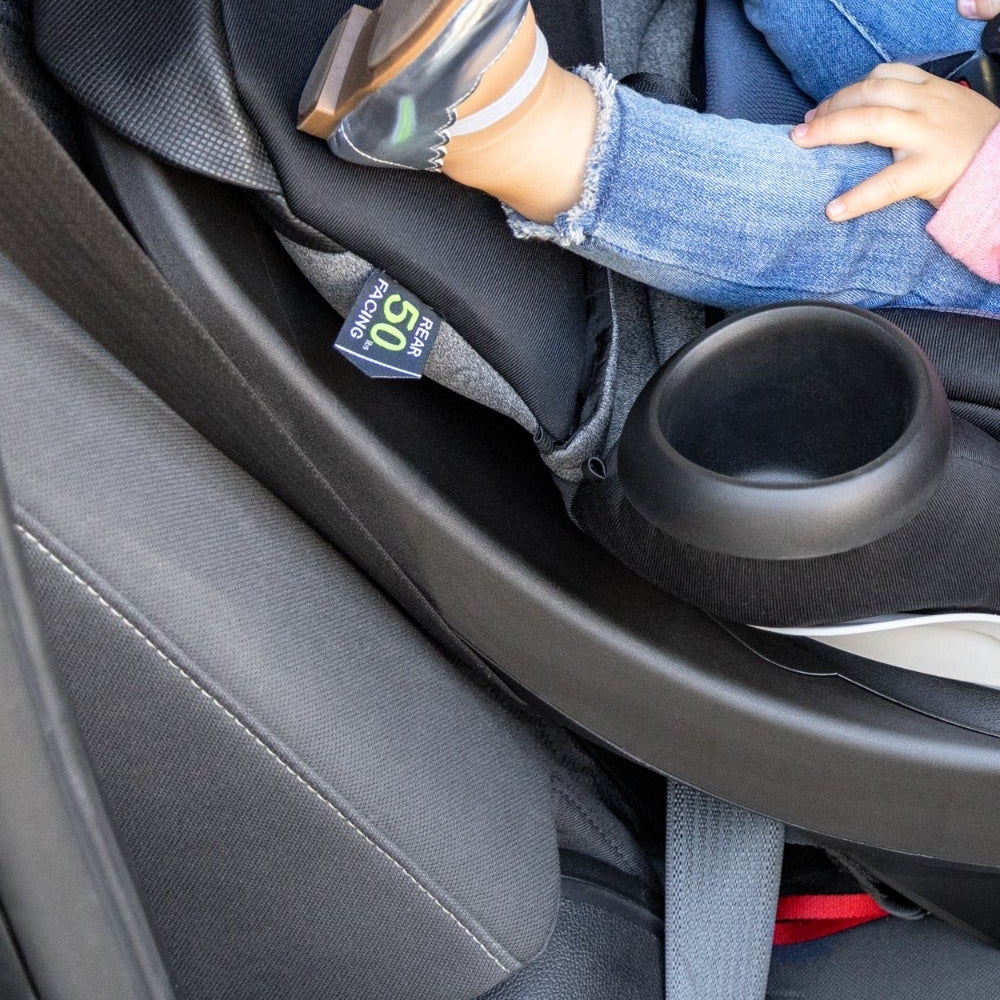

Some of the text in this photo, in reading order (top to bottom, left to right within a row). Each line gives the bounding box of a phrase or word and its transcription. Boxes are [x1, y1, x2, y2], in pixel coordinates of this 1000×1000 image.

[350, 278, 389, 339] FACING
[362, 294, 420, 351] 50 lbs
[407, 316, 434, 358] REAR
